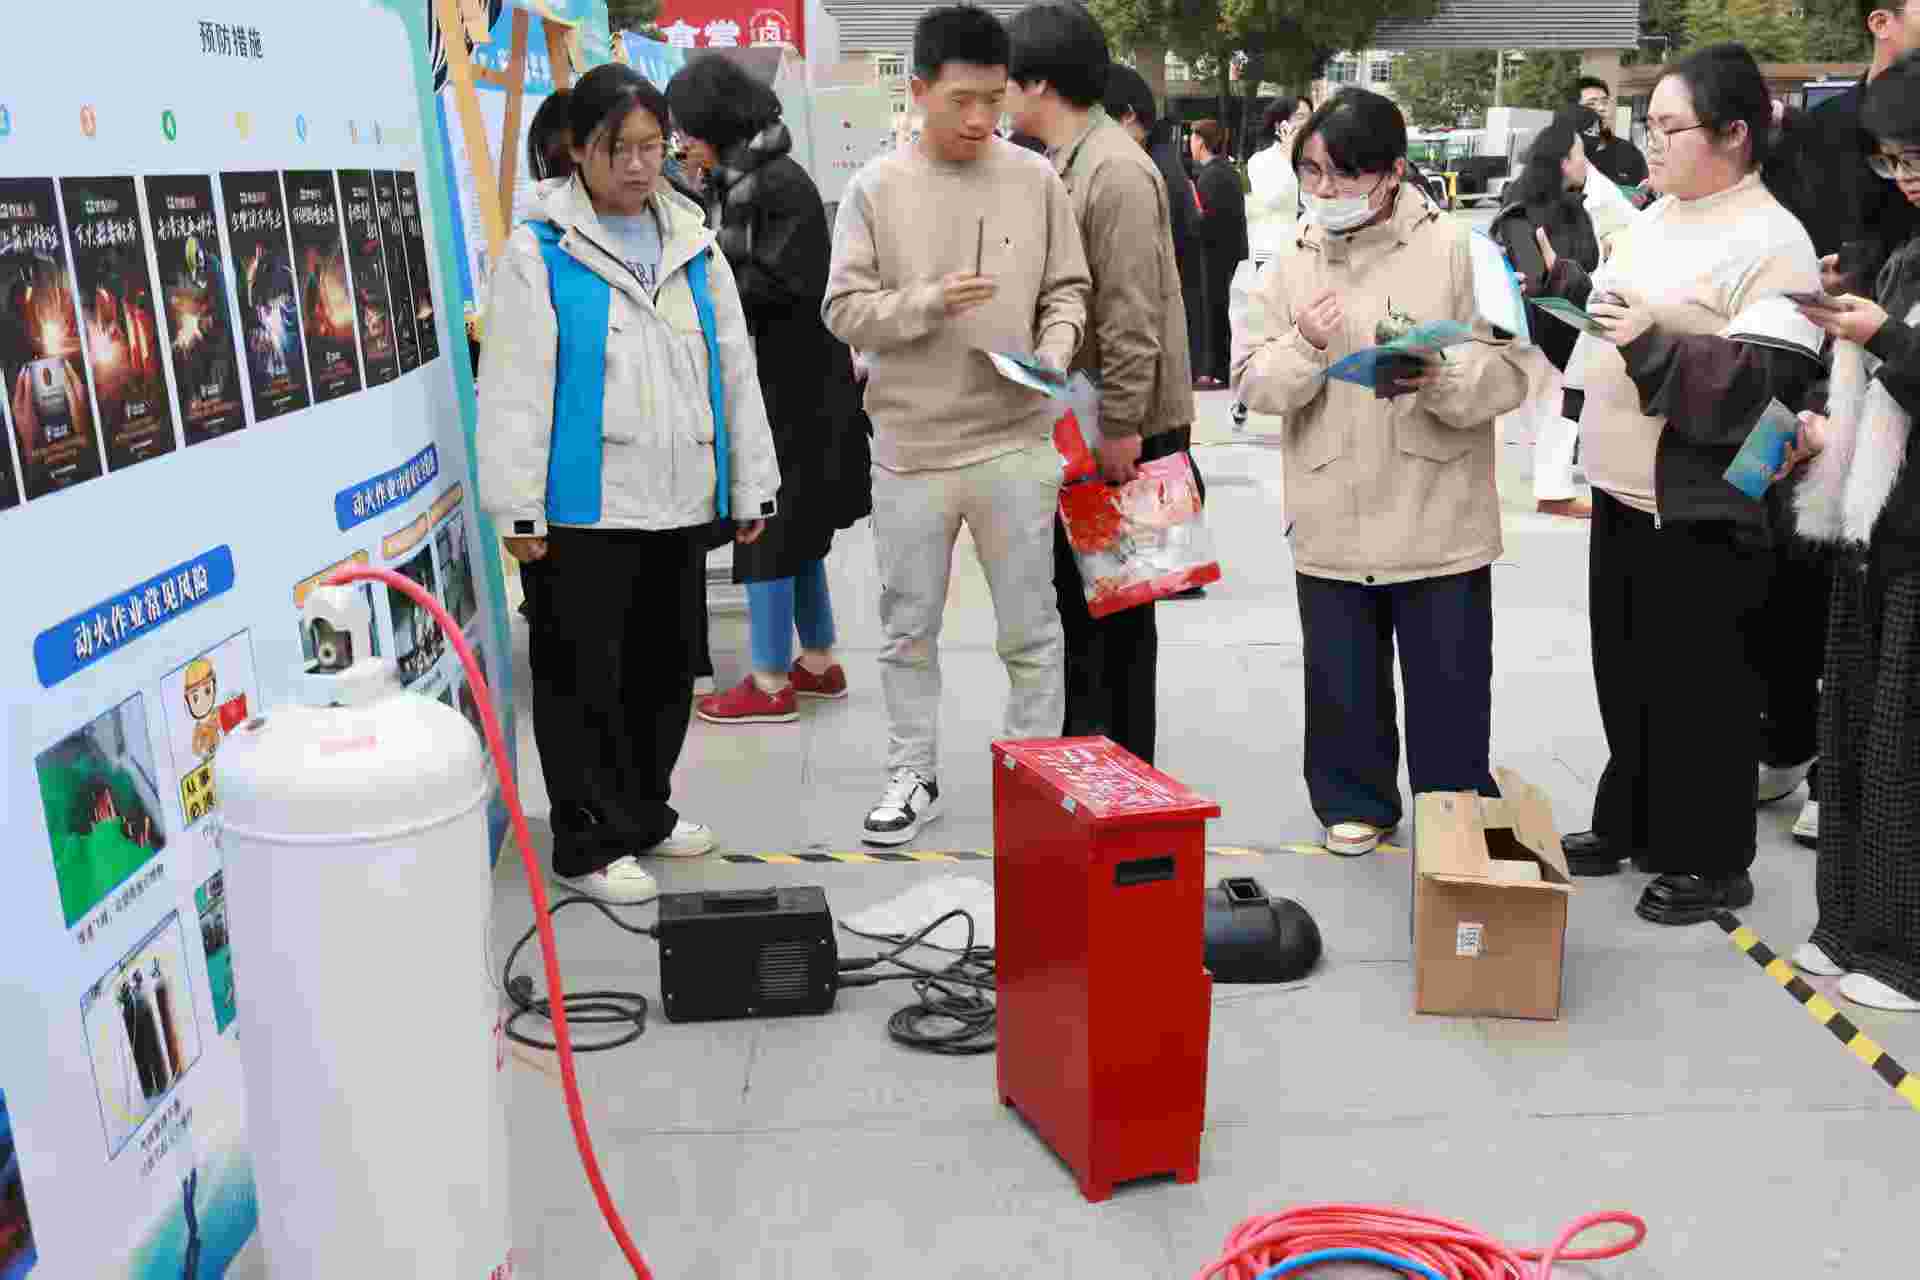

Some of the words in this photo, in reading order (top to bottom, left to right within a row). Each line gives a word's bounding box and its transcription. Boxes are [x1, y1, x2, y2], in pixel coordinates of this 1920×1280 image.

[199, 22, 264, 58] 预防措施
[75, 565, 208, 659] 动火作业常见风险
